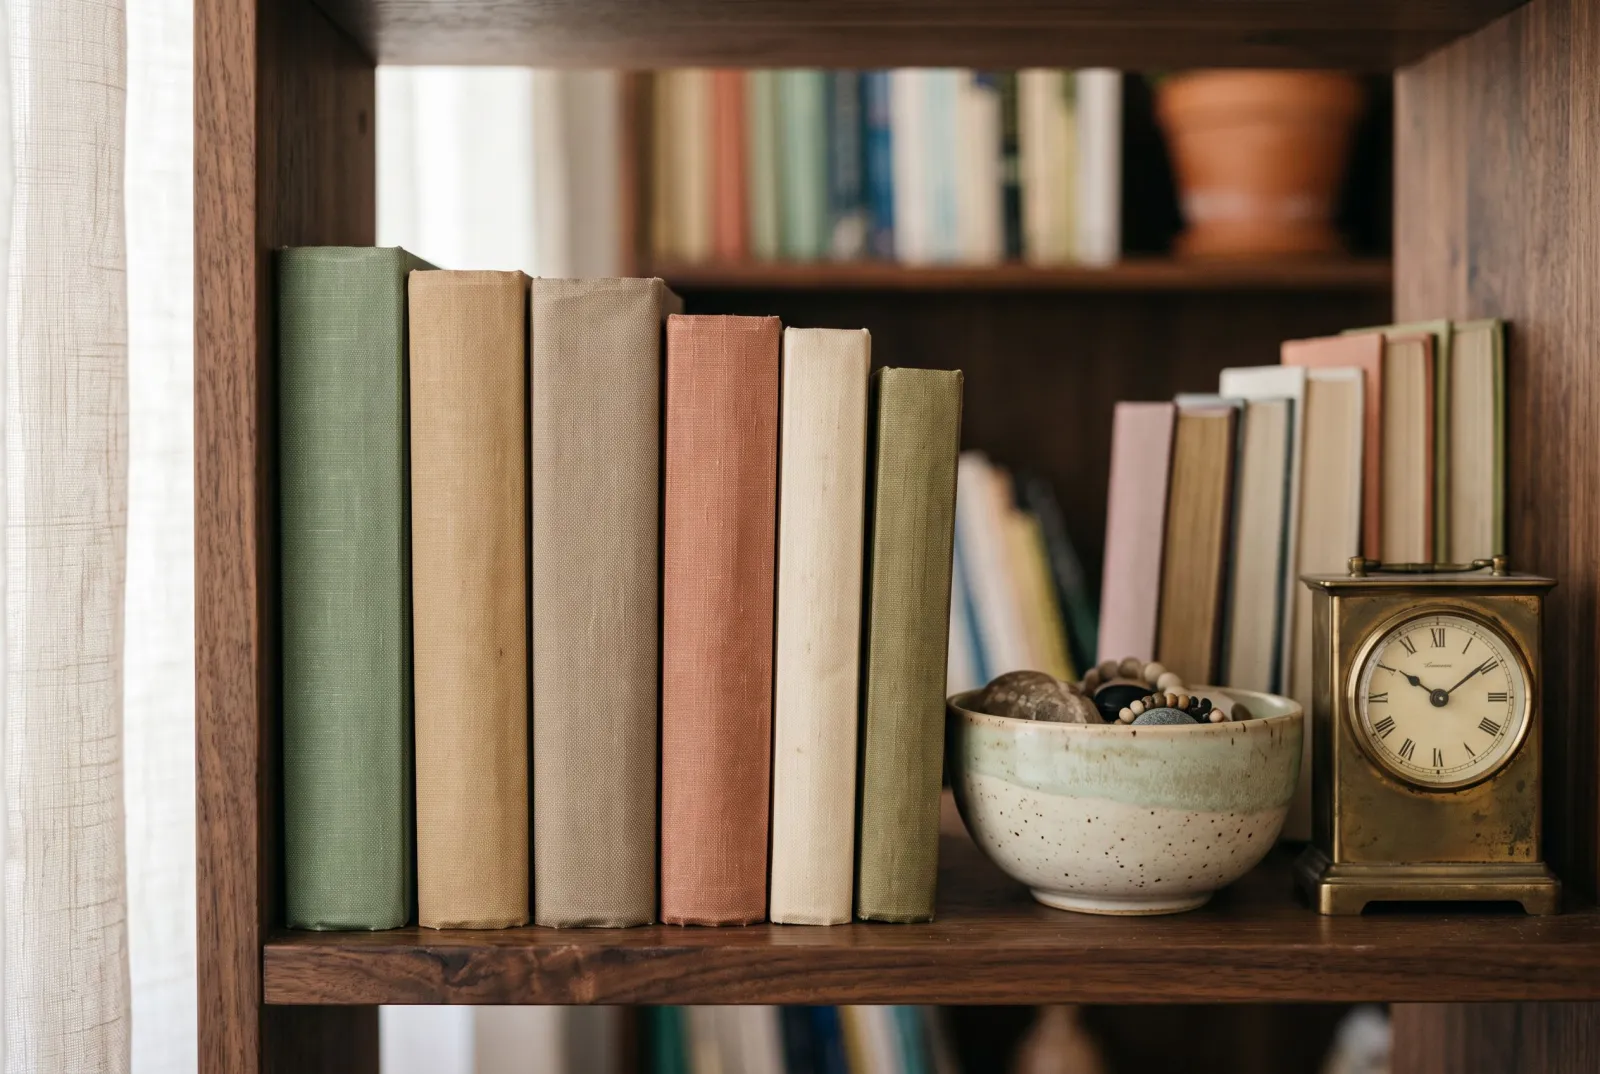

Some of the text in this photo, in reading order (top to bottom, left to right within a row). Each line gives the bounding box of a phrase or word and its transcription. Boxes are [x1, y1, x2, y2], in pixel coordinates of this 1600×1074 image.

[1399, 635, 1417, 658] XI
[1430, 628, 1446, 648] XII
[1462, 637, 1473, 655] I
[1376, 659, 1397, 676] X
[1368, 691, 1389, 704] IX
[1487, 691, 1508, 703] III
[1374, 714, 1397, 740] VIII
[1477, 716, 1502, 737] IIII
[1398, 738, 1416, 761] VII
[1432, 748, 1444, 767] VI
[1463, 741, 1476, 760] V
